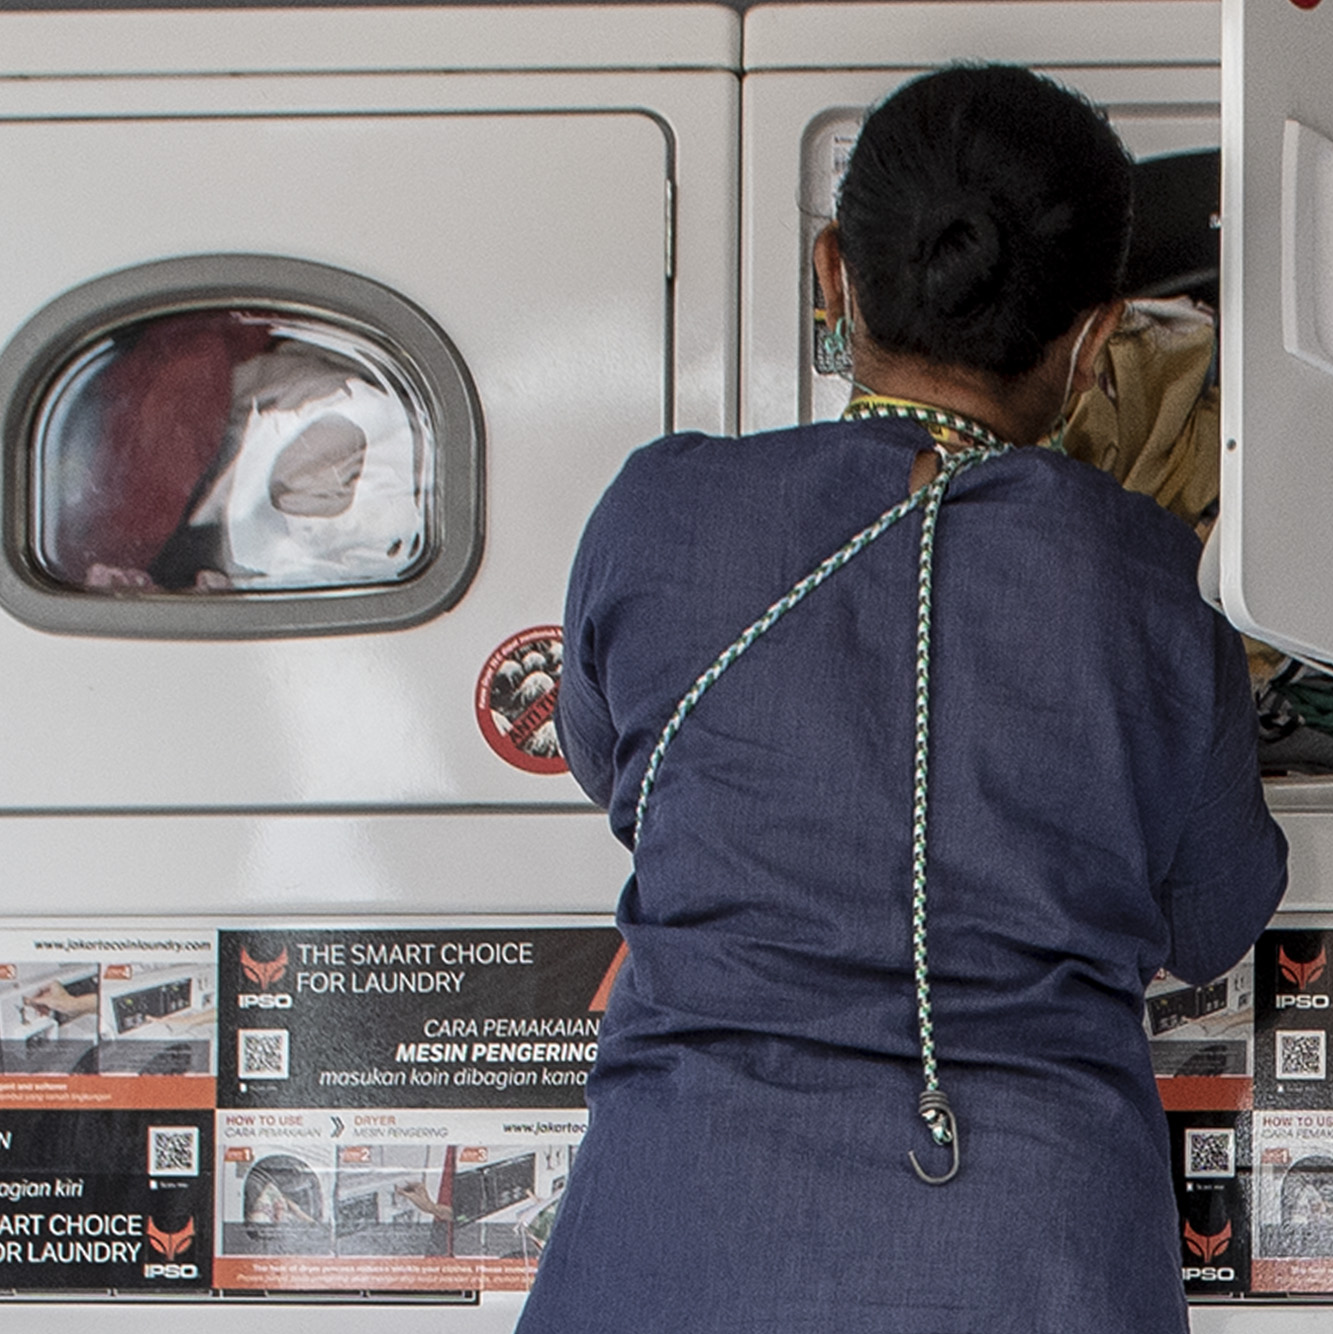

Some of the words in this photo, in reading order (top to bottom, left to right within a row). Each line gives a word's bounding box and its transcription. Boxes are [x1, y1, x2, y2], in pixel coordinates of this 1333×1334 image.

[297, 942, 346, 966] THE
[350, 943, 436, 966] SMART
[440, 942, 534, 965] CHOICE
[296, 971, 346, 994] FOR
[351, 971, 465, 994] LAUNDRY
[238, 993, 293, 1009] IPSO
[1275, 994, 1330, 1009] IPSO
[423, 1018, 479, 1038] CARA
[482, 1018, 599, 1037] PEMAKAIAN
[395, 1043, 468, 1063] MESIN
[471, 1042, 599, 1062] PENGERING
[318, 1066, 407, 1093] masukan
[409, 1067, 450, 1087] koin
[453, 1067, 538, 1091] dibagian
[541, 1067, 589, 1086] kana
[56, 1180, 85, 1199] kiri
[53, 1215, 142, 1236] CHOICE
[27, 1242, 142, 1263] LAUNDRY
[144, 1264, 198, 1279] IPSO
